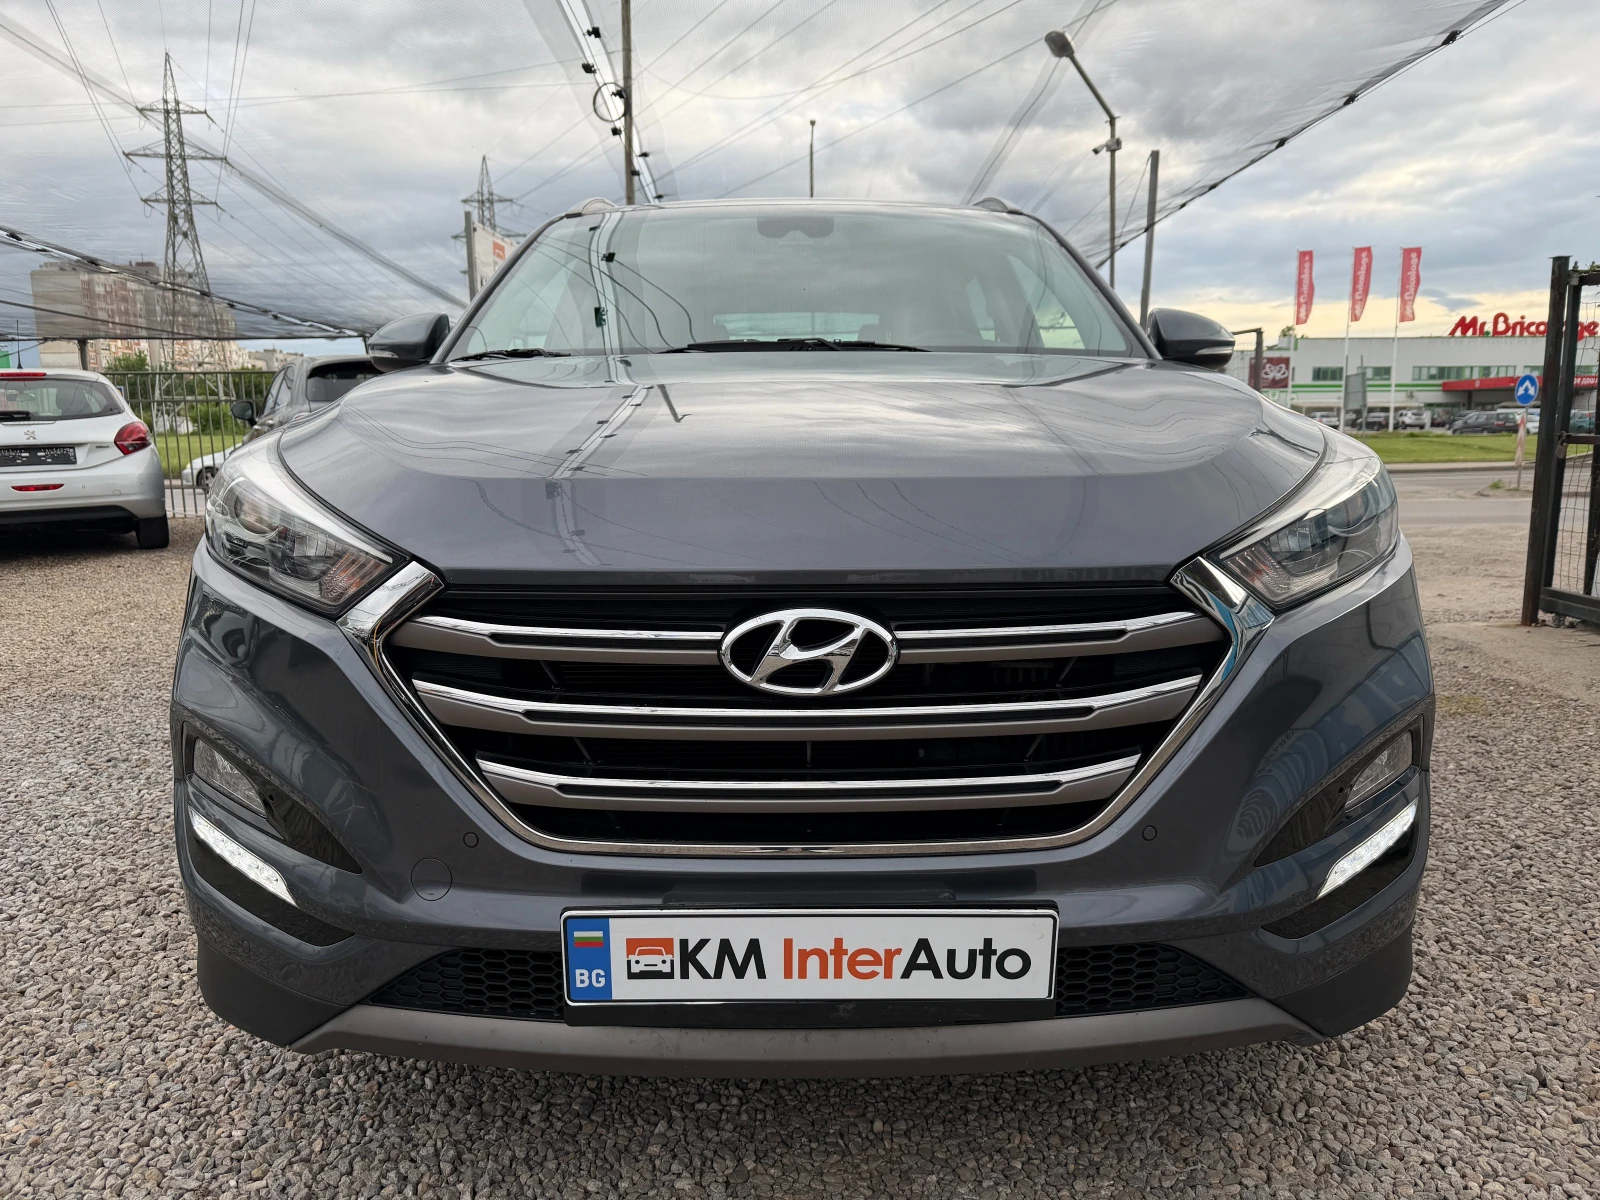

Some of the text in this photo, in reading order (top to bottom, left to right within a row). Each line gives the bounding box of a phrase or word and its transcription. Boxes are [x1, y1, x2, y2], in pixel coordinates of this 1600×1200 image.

[679, 938, 1032, 980] KM InterAuto
[575, 969, 606, 989] BG
